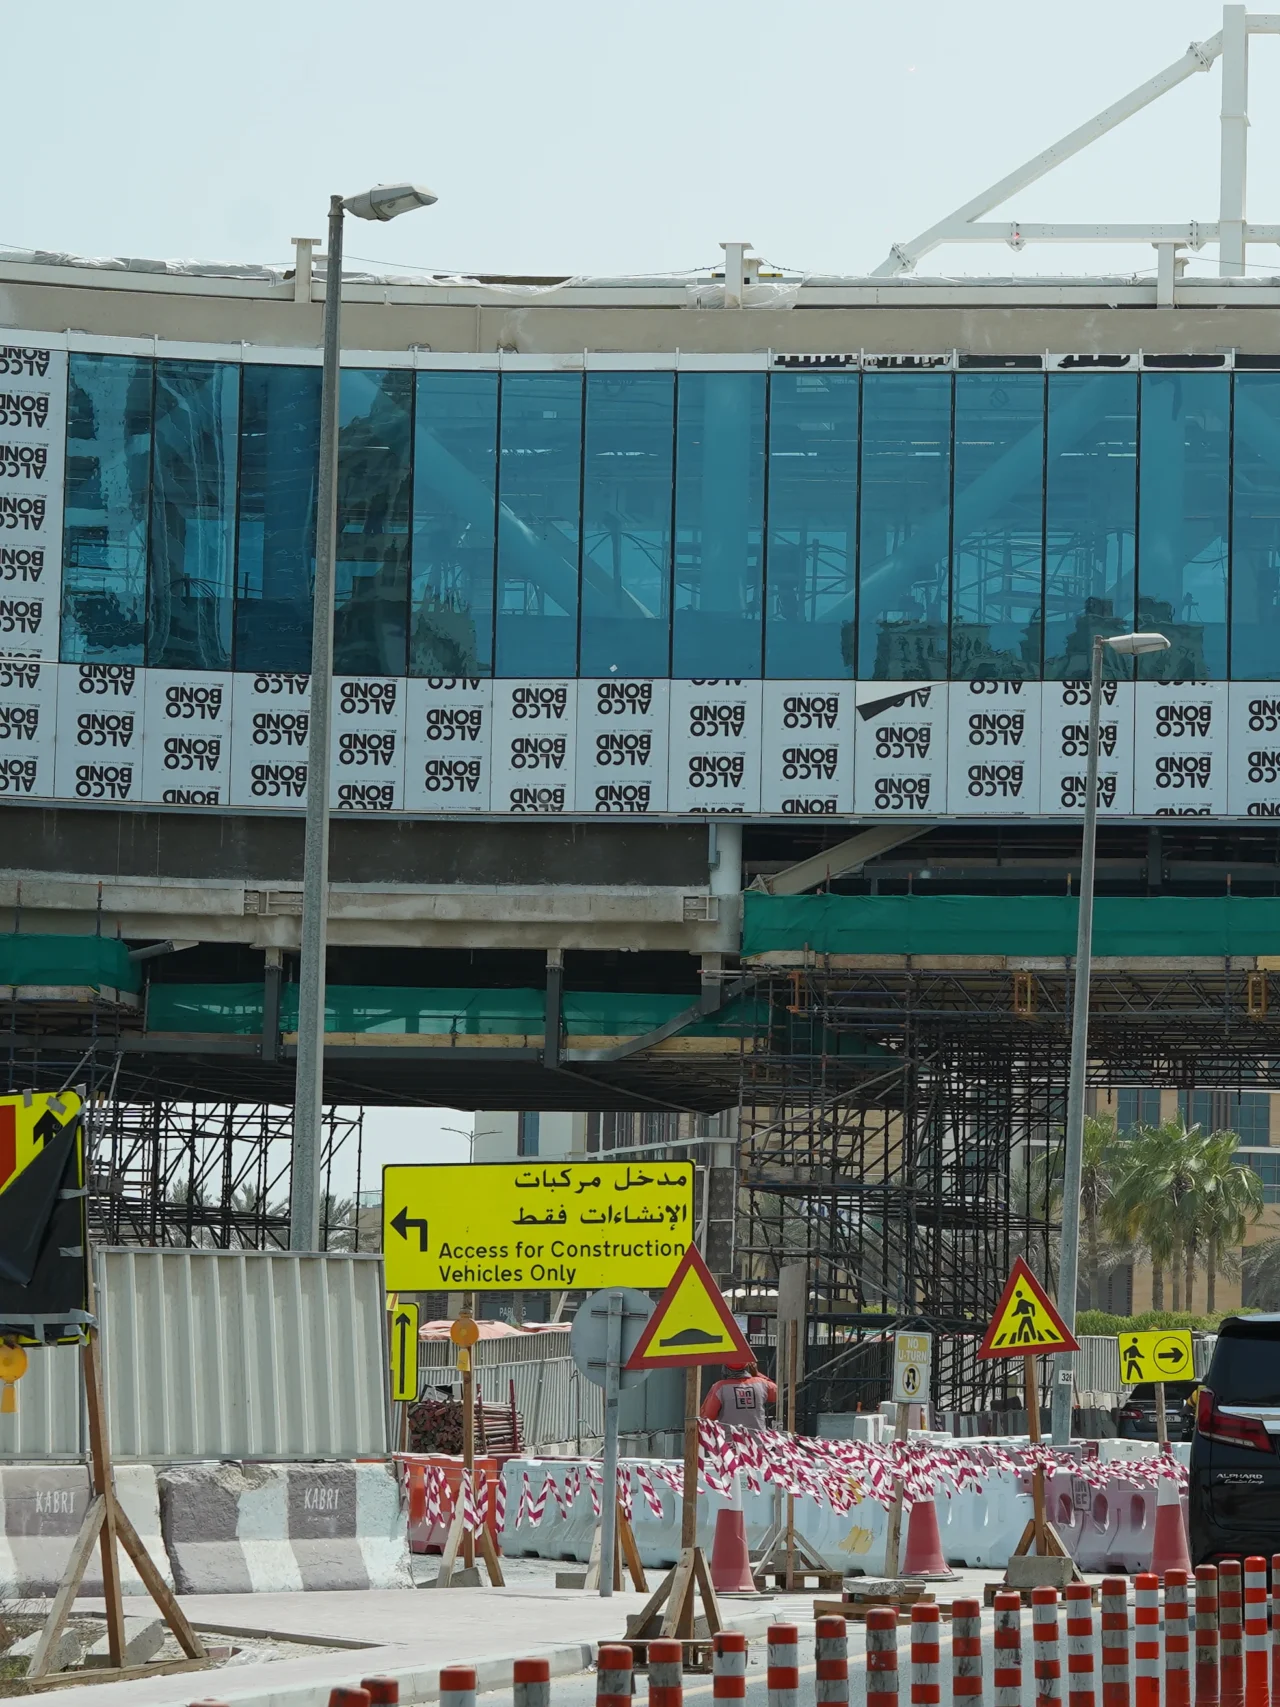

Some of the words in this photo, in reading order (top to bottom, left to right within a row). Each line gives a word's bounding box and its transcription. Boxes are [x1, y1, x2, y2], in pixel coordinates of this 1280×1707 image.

[166, 687, 221, 704] BOND
[341, 683, 396, 699] BOND
[513, 688, 567, 704] BOND
[598, 683, 652, 699] BOND
[166, 702, 220, 719] ALCO
[341, 698, 395, 714] ALCO
[513, 702, 566, 718] ALCO
[598, 698, 651, 714] ALCO
[690, 706, 744, 722] BOND
[784, 698, 838, 714] BOND
[1156, 706, 1211, 722] BOND
[78, 714, 133, 732] BOND
[253, 714, 308, 730] BOND
[427, 710, 481, 726] BOND
[784, 712, 837, 728] ALCO
[969, 714, 1024, 730] BOND
[427, 725, 480, 741] ALCO
[690, 720, 743, 736] ALCO
[876, 727, 930, 743] BOND
[1156, 720, 1210, 736] ALCO
[78, 730, 132, 747] ALCO
[253, 728, 307, 745] ALCO
[339, 734, 394, 750] BOND
[596, 734, 651, 750] BOND
[969, 729, 1023, 745] ALCO
[164, 738, 220, 756] BOND
[511, 738, 565, 754] BOND
[876, 742, 929, 758] ALCO
[164, 754, 219, 771] ALCO
[339, 749, 393, 765] ALCO
[511, 752, 564, 768] ALCO
[596, 749, 650, 765] ALCO
[689, 757, 743, 772] BOND
[783, 749, 837, 764] BOND
[425, 761, 480, 777] BOND
[783, 764, 836, 779] ALCO
[1156, 757, 1210, 773] BOND
[76, 765, 132, 783] BOND
[251, 765, 307, 782] BOND
[689, 772, 742, 787] ALCO
[968, 766, 1023, 782] BOND
[1156, 772, 1209, 788] ALCO
[76, 781, 131, 799] ALCO
[251, 780, 306, 796] ALCO
[425, 776, 479, 792] ALCO
[875, 779, 929, 794] BOND
[968, 780, 1022, 796] ALCO
[875, 794, 928, 809] ALCO
[514, 1168, 601, 1193] مركبات
[614, 1167, 687, 1191] مدخل
[510, 1204, 568, 1225] فقط
[580, 1204, 687, 1230] الإنشاءات
[438, 1241, 510, 1259] Access
[516, 1240, 545, 1258] for
[550, 1239, 686, 1258] Construction
[438, 1264, 522, 1283] Vehicles
[530, 1264, 576, 1284] Only
[907, 1337, 919, 1349] NO
[898, 1350, 927, 1362] U-TURN
[35, 1491, 76, 1514] KABRI
[304, 1488, 338, 1511] KABRI
